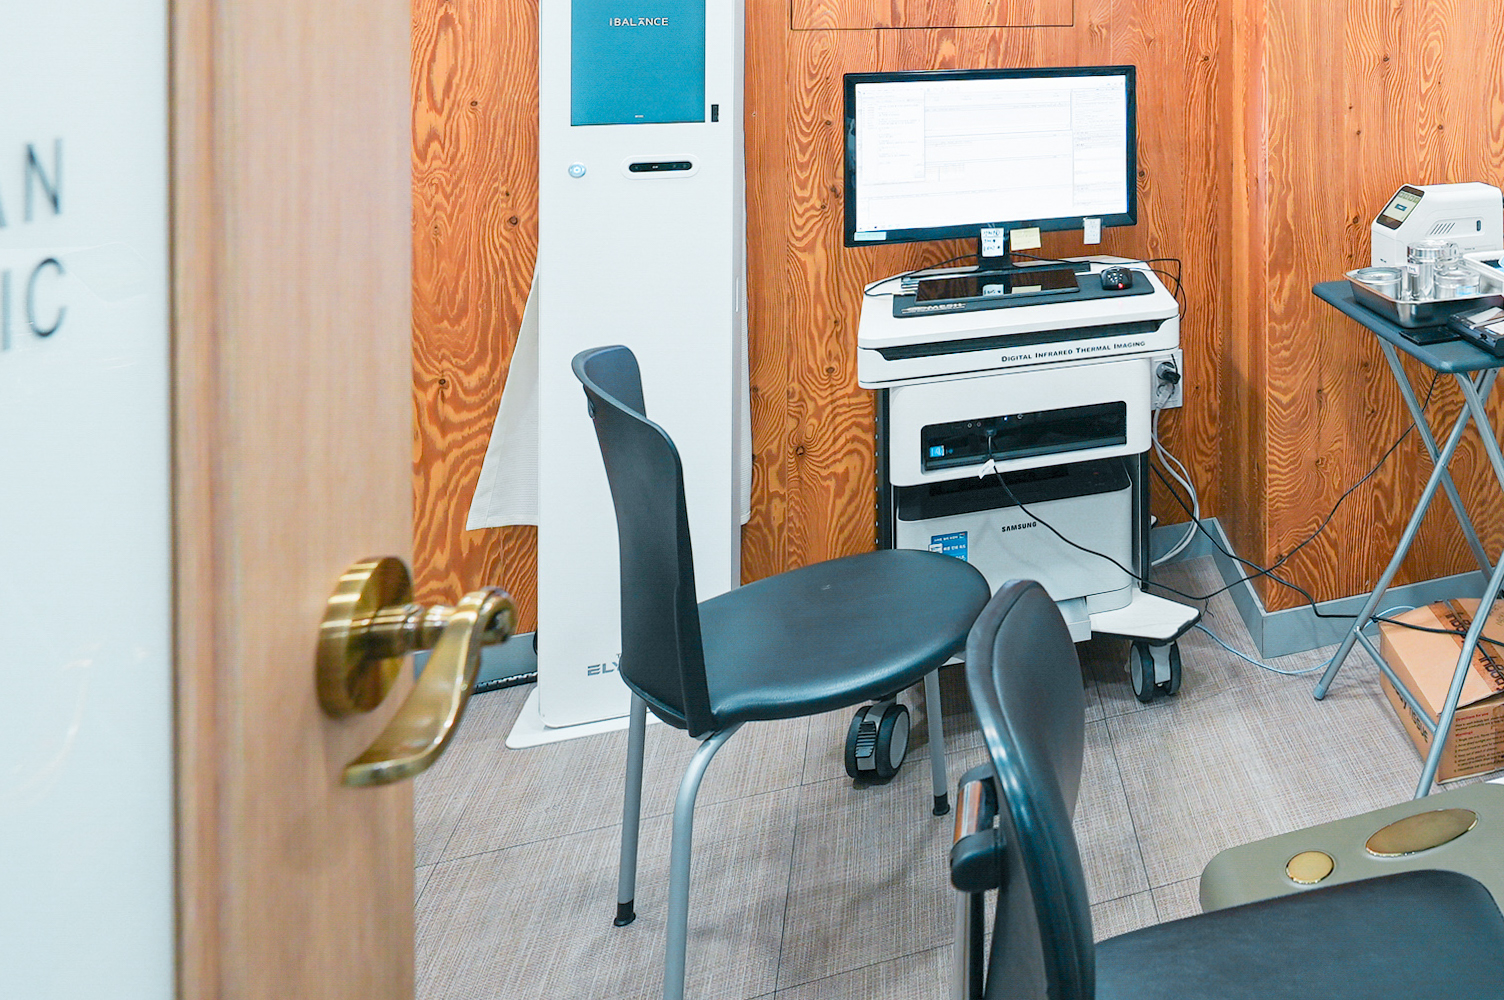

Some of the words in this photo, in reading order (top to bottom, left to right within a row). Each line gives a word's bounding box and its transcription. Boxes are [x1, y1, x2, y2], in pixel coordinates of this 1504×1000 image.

[0, 137, 64, 228] N
[1002, 354, 1032, 362] DIGITAL
[1035, 349, 1073, 359] INFRARED
[1076, 344, 1111, 354] THERMAL
[1114, 341, 1146, 350] IMAGING
[1001, 521, 1037, 533] SAMSUNG
